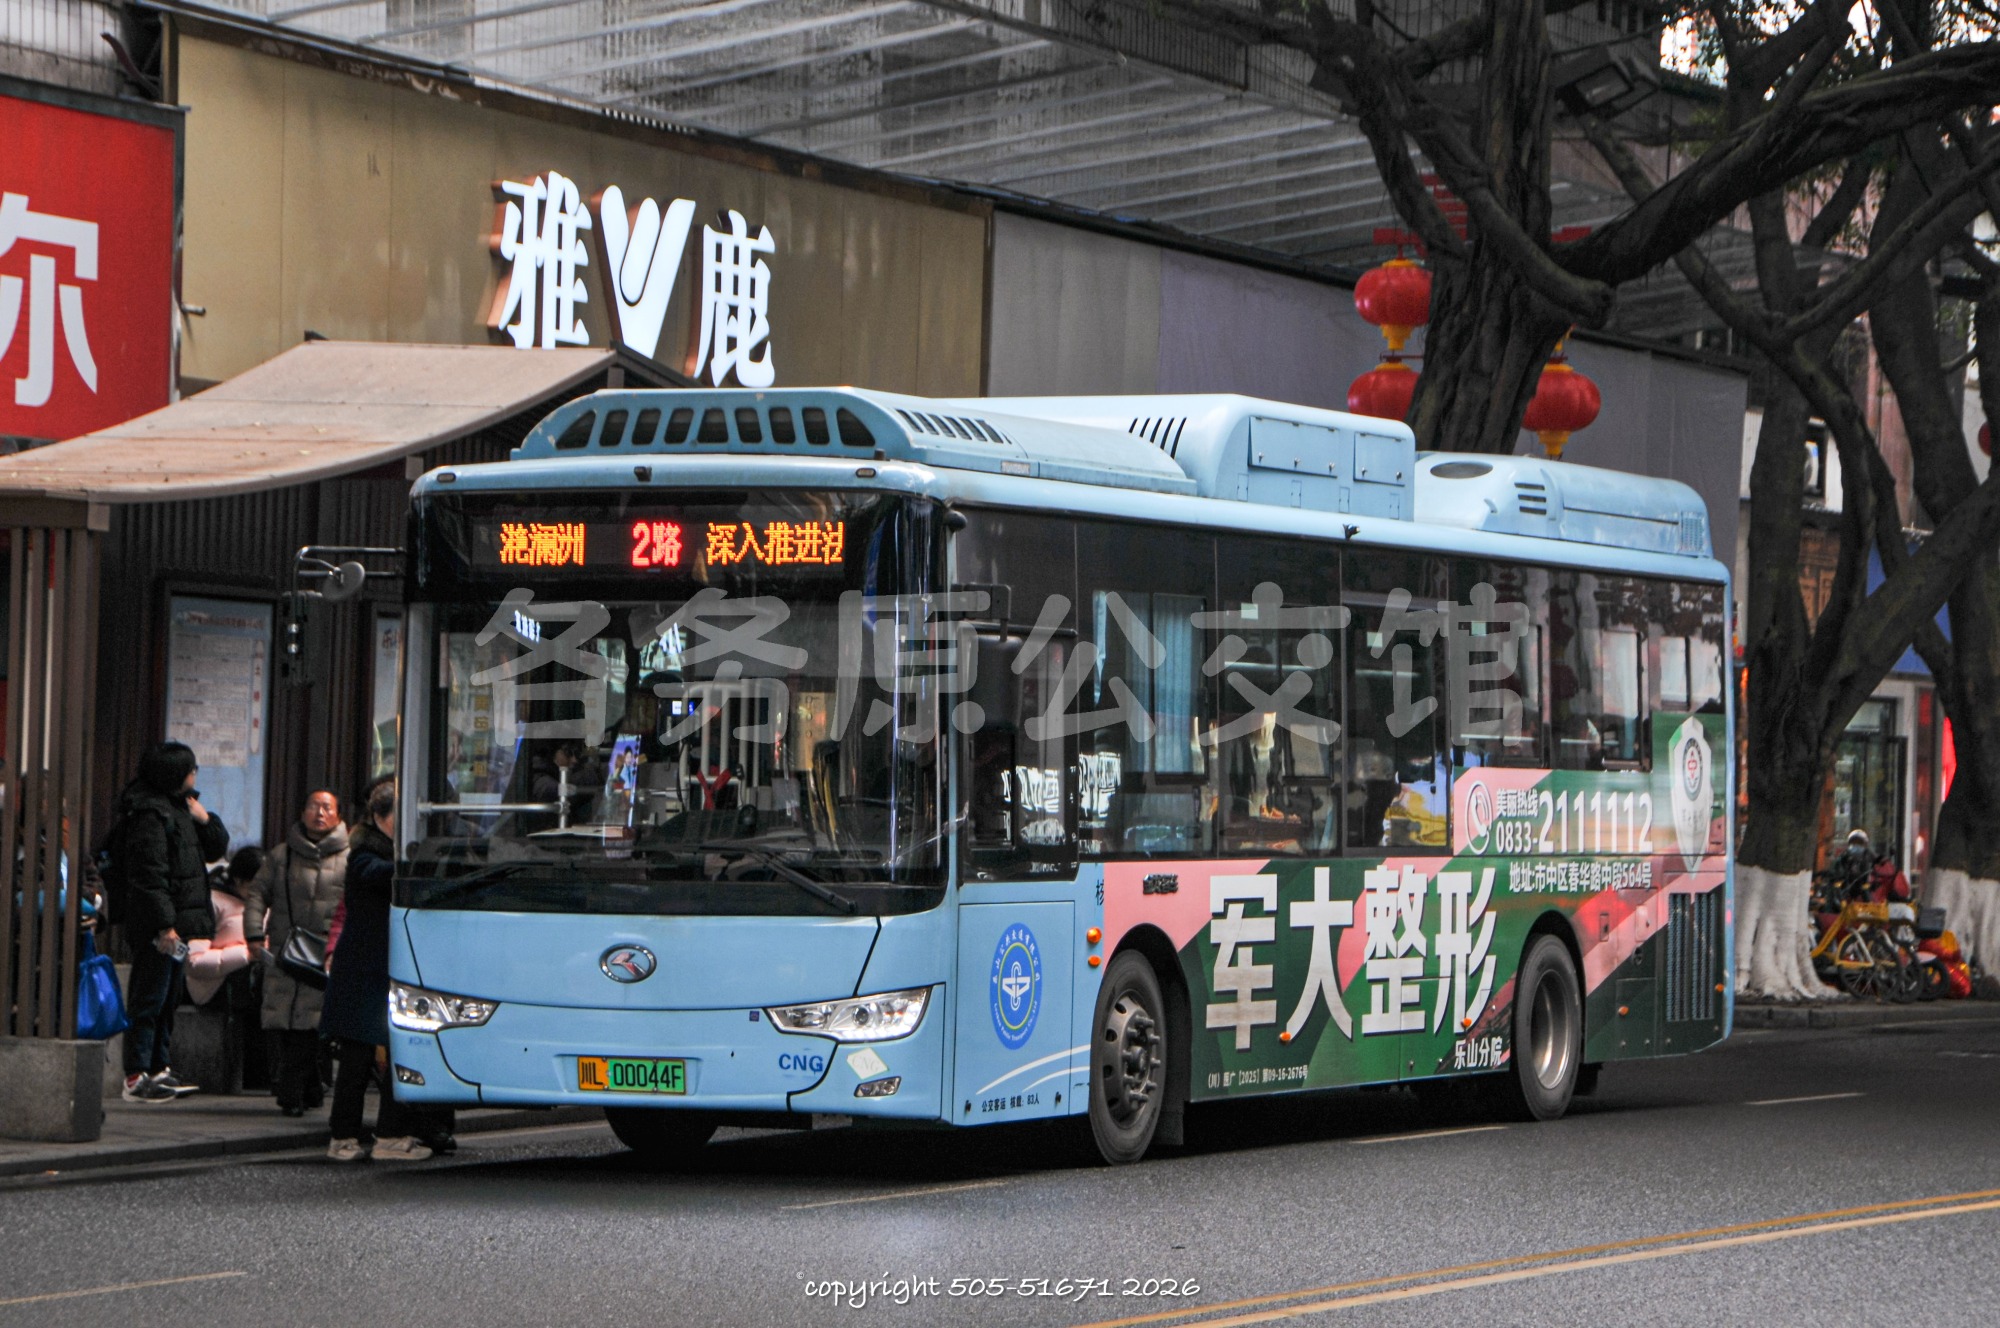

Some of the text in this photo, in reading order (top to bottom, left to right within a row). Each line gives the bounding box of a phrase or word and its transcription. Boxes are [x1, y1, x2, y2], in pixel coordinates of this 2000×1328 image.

[632, 522, 682, 566] 2路
[1496, 789, 1538, 817] 美丽热线
[1206, 864, 1497, 1050] 军大整形
[778, 1053, 824, 1074] CNG
[1454, 1036, 1503, 1069] 乐山分院
